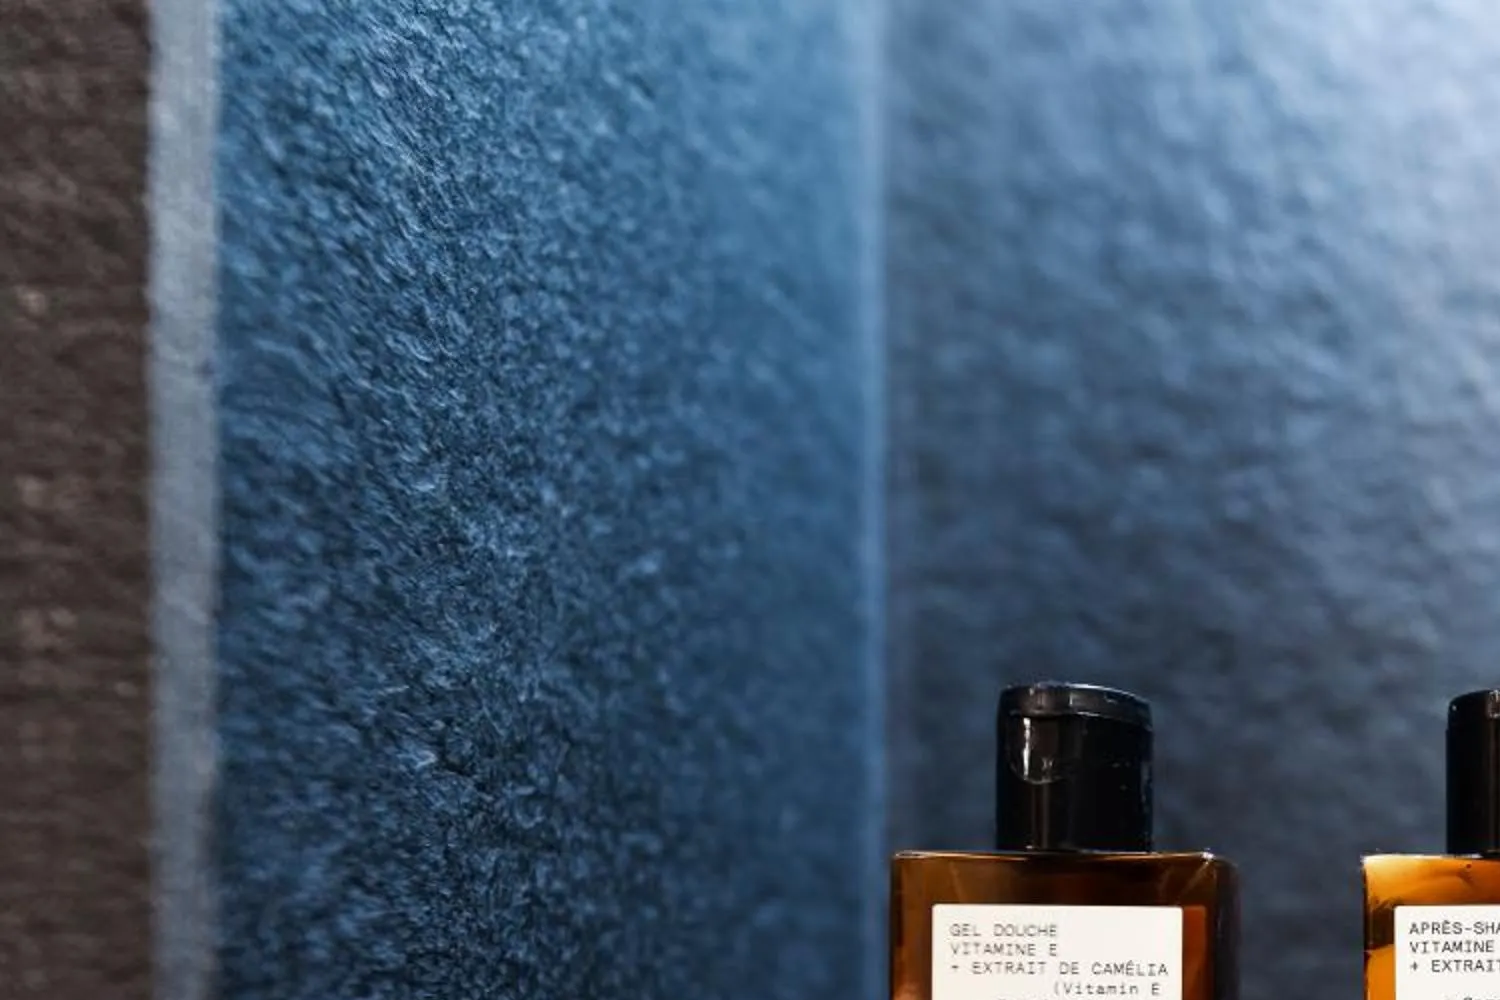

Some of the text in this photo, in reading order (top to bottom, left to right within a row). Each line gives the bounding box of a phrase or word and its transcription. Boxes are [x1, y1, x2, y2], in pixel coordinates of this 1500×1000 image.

[950, 923, 1057, 938] GEL DOUCHE
[951, 941, 1057, 957] VITAMINE E
[1409, 939, 1495, 955] VITAMINE
[972, 961, 1047, 976] EXTRAIT
[1059, 961, 1080, 976] DE
[1091, 959, 1169, 977] CAMÉLIA
[1054, 982, 1160, 996] (Vitamin E
